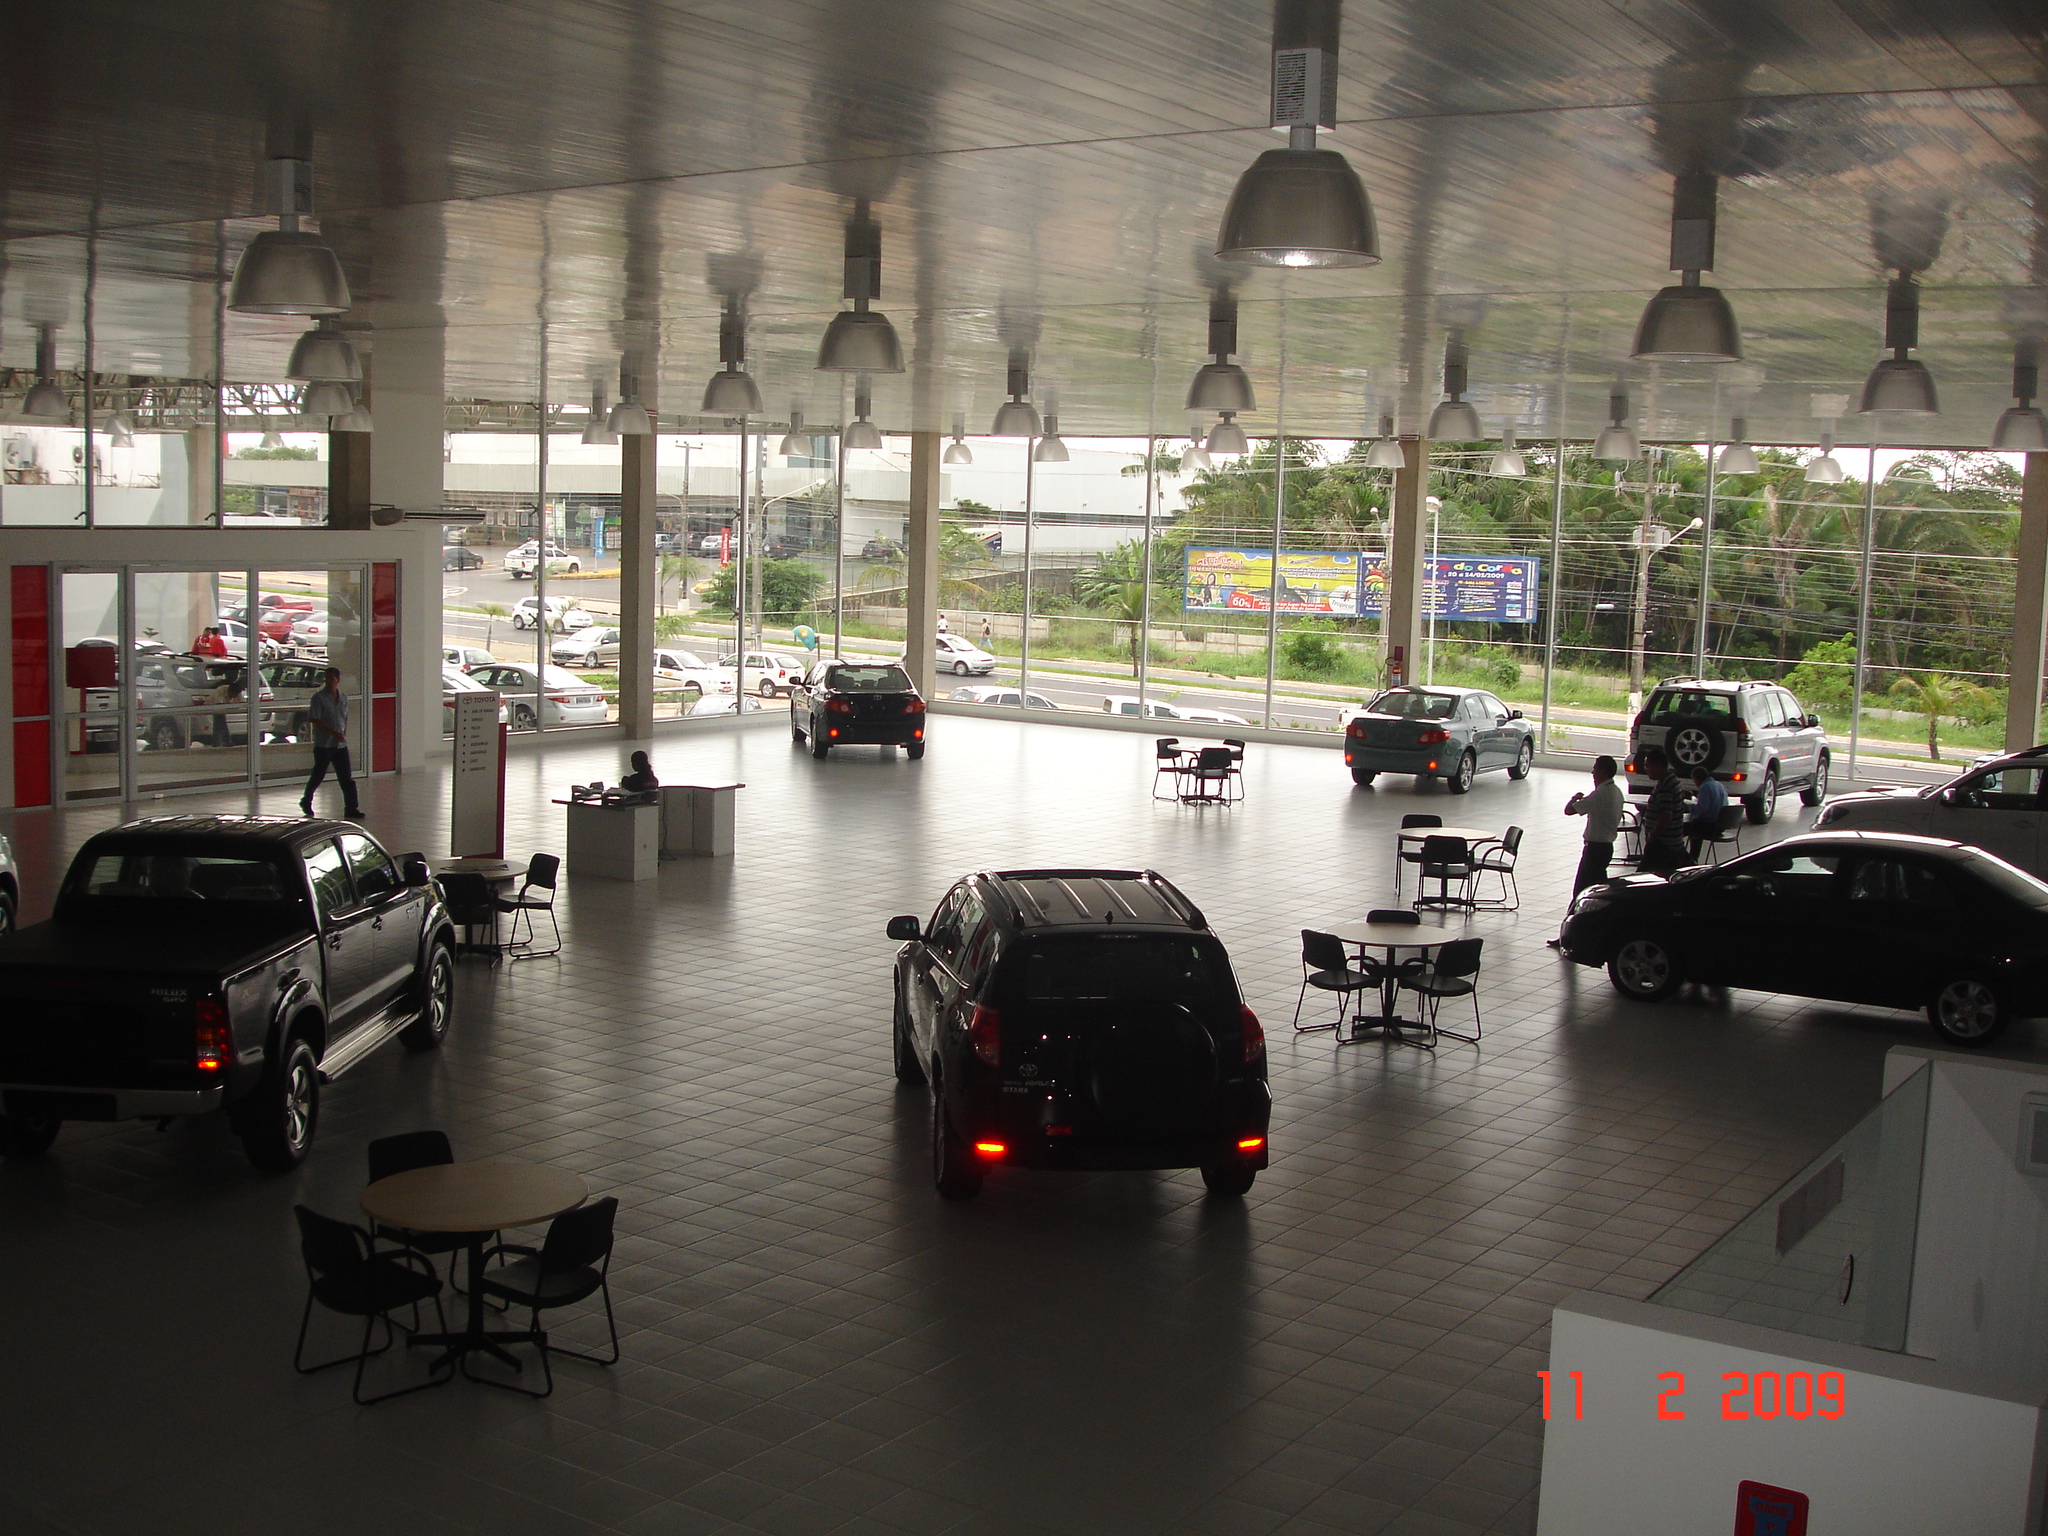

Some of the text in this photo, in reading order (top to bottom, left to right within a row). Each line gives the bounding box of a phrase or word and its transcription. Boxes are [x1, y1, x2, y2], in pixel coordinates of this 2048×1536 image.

[1453, 562, 1473, 571] do
[1477, 564, 1523, 575] Corda
[1232, 597, 1252, 608] 60%
[150, 988, 187, 996] HILUX
